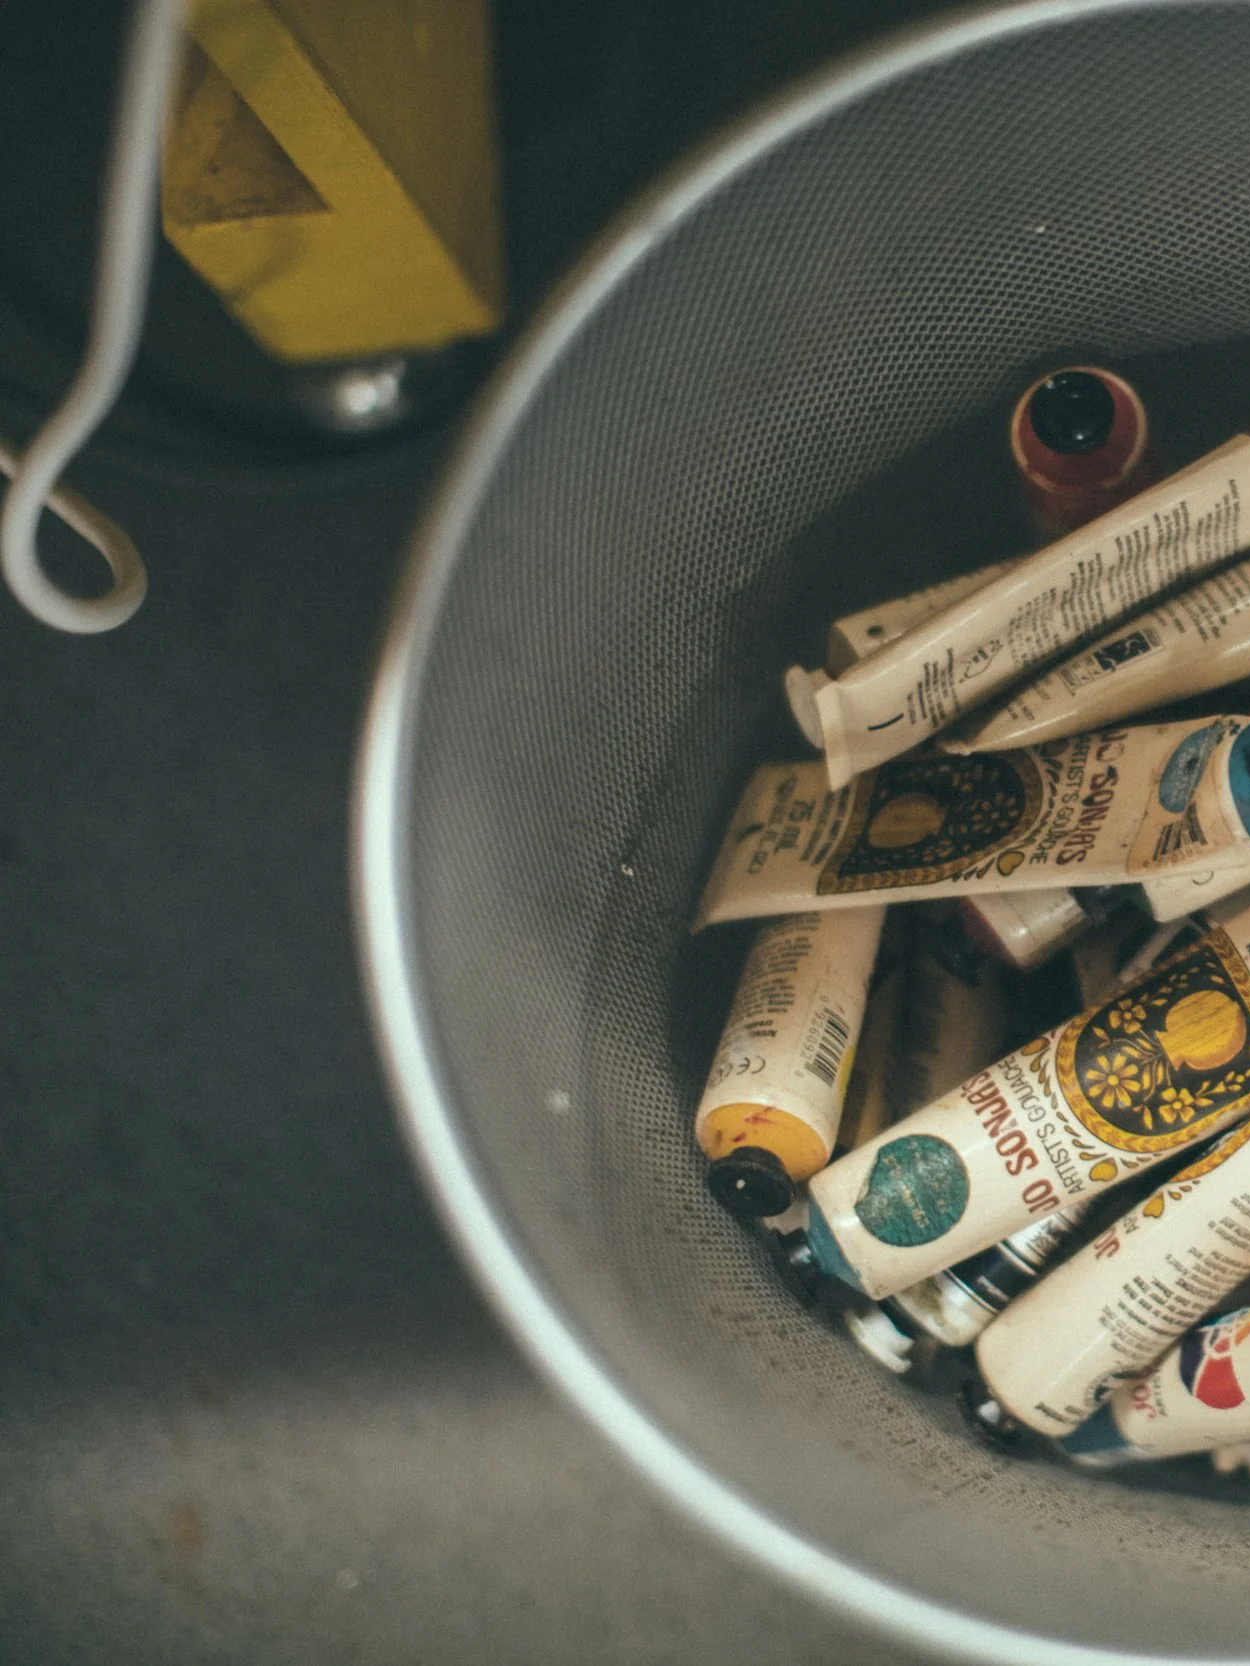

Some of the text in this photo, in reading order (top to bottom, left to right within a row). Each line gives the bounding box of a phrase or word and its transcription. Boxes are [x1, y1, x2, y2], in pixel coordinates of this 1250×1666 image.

[1057, 767, 1119, 865] SONJA'S
[960, 1069, 1041, 1180] SONJA'S
[997, 1054, 1048, 1124] GOUACHE
[1018, 1175, 1062, 1218] JO
[1033, 1121, 1088, 1197] ARTIST'S
